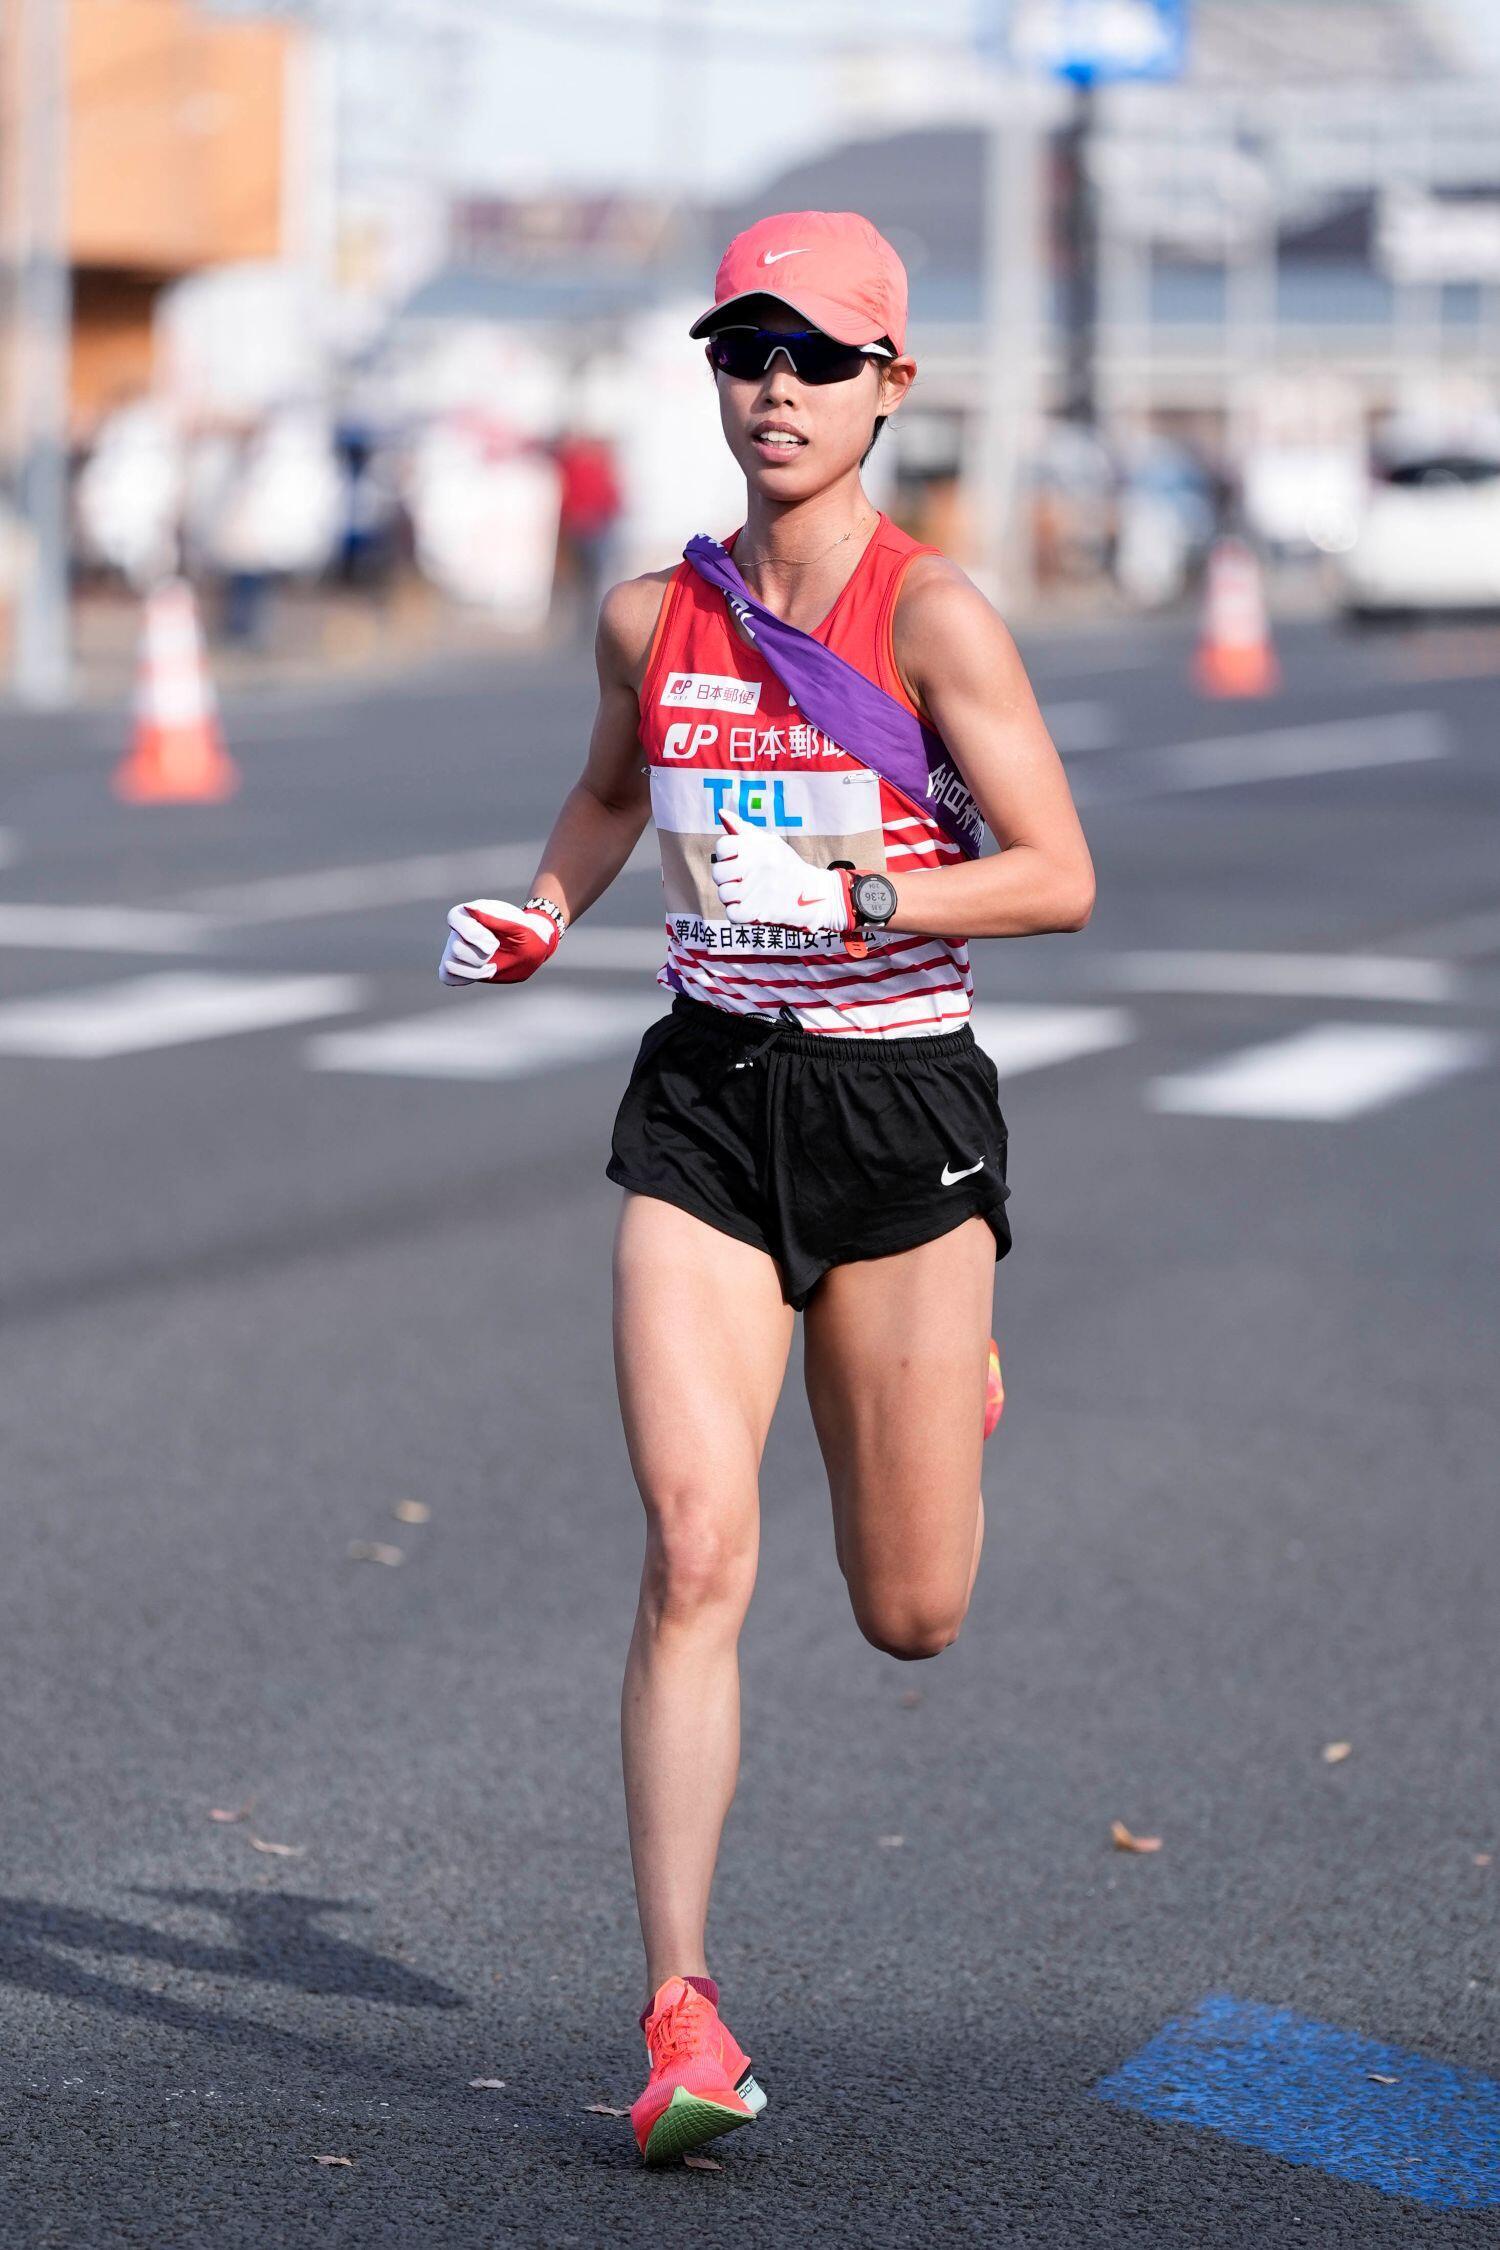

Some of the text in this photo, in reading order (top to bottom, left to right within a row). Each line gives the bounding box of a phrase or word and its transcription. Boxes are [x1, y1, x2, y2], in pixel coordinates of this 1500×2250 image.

[697, 684, 756, 705] 日本郵便
[662, 722, 719, 759] JP
[703, 778, 803, 828] TEL
[926, 762, 985, 848] 全日本
[864, 892, 887, 902] 2:36
